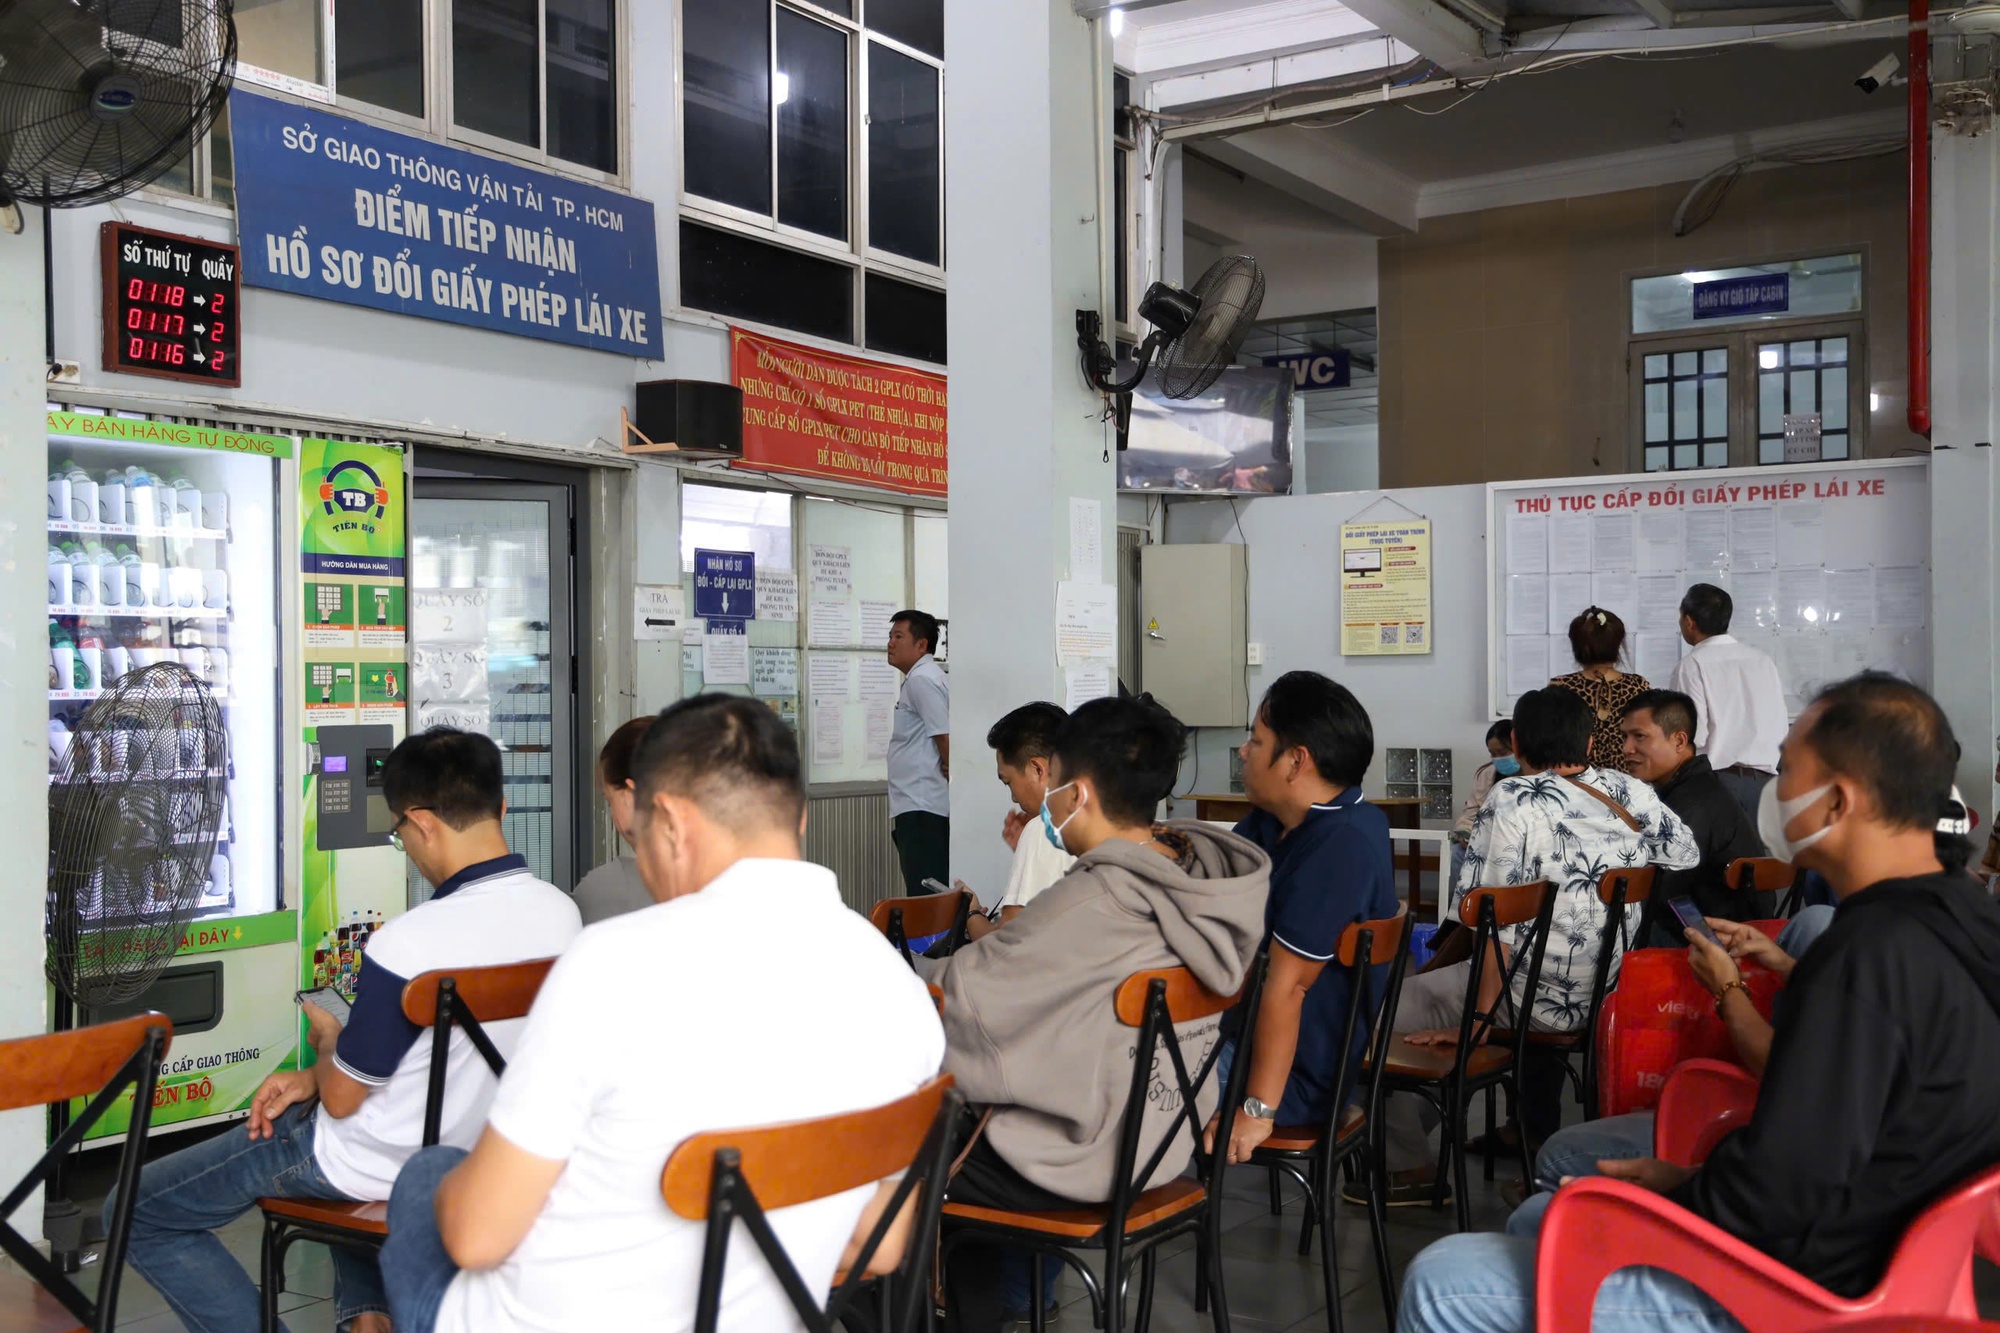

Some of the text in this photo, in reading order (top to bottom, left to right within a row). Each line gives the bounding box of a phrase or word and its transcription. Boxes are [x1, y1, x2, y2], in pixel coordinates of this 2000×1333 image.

[282, 123, 624, 232] SỞ GIAO THÔNG VẬN TẢI TP. HCM
[355, 184, 577, 277] ĐIỂM TIẾP NHẬN
[124, 240, 234, 281] SỐ THỨ TỰ QUẦY
[128, 278, 225, 314] 0118 2
[266, 225, 648, 345] HỒ SƠ ĐỔI GIẤY PHÉP LÁI XE
[1699, 284, 1784, 308] ĐĂNG KÝ GIỜ TẬP CABIN
[127, 308, 225, 342] 0117 2
[129, 337, 225, 371] 0116 2
[1279, 356, 1335, 385] WC
[776, 357, 805, 379] NGƯỜI
[826, 367, 850, 390] ĐƯỢC
[851, 371, 873, 393] TÁCH
[875, 379, 879, 394] 2
[881, 379, 900, 398] GPLX
[917, 385, 934, 405] THỜI
[936, 390, 947, 410] HẠ
[741, 377, 774, 399] NHƯNG
[775, 381, 791, 403] CHỈ
[814, 388, 826, 410] SỐ
[826, 396, 848, 415] GPLX
[849, 401, 865, 418] PET
[914, 413, 928, 430] KHI
[930, 413, 945, 435] NỘP
[47, 412, 275, 455] ÁY BÁN HÀNG TỰ ĐỘNG
[768, 406, 786, 430] CẤP
[787, 409, 799, 432] SỐ
[801, 417, 824, 437] GPLX
[823, 423, 840, 441] PET
[841, 426, 860, 444] CHO
[862, 426, 878, 447] CÁN
[879, 430, 890, 453] BỘ
[892, 430, 909, 453] TIẾP
[911, 437, 932, 459] NHẬN
[933, 436, 944, 458] HỒ
[817, 442, 829, 466] ĐỂ
[831, 450, 860, 470] KHÔNG
[887, 462, 912, 480] TRONG
[914, 463, 930, 485] QUÁ
[931, 465, 948, 485] TRÌN
[342, 491, 367, 507] TB
[1515, 476, 1885, 513] THỦ TỤC CẤP ĐỔI GIẤY PHÉP LÁI XE
[321, 560, 344, 568] HƯỚNG
[345, 561, 357, 569] DẪN
[373, 562, 388, 571] HÀNG
[697, 571, 752, 592] ĐỔI CẤP LẠI GPLX
[707, 556, 743, 573] NHẬN HỒ SƠ
[463, 591, 485, 607] SỐ
[443, 615, 453, 632] 2
[443, 672, 452, 689] 3
[200, 927, 229, 946] ĐÂY
[173, 1047, 260, 1074] CẤP GIAO THÔNG
[186, 1076, 213, 1102] BỘ
